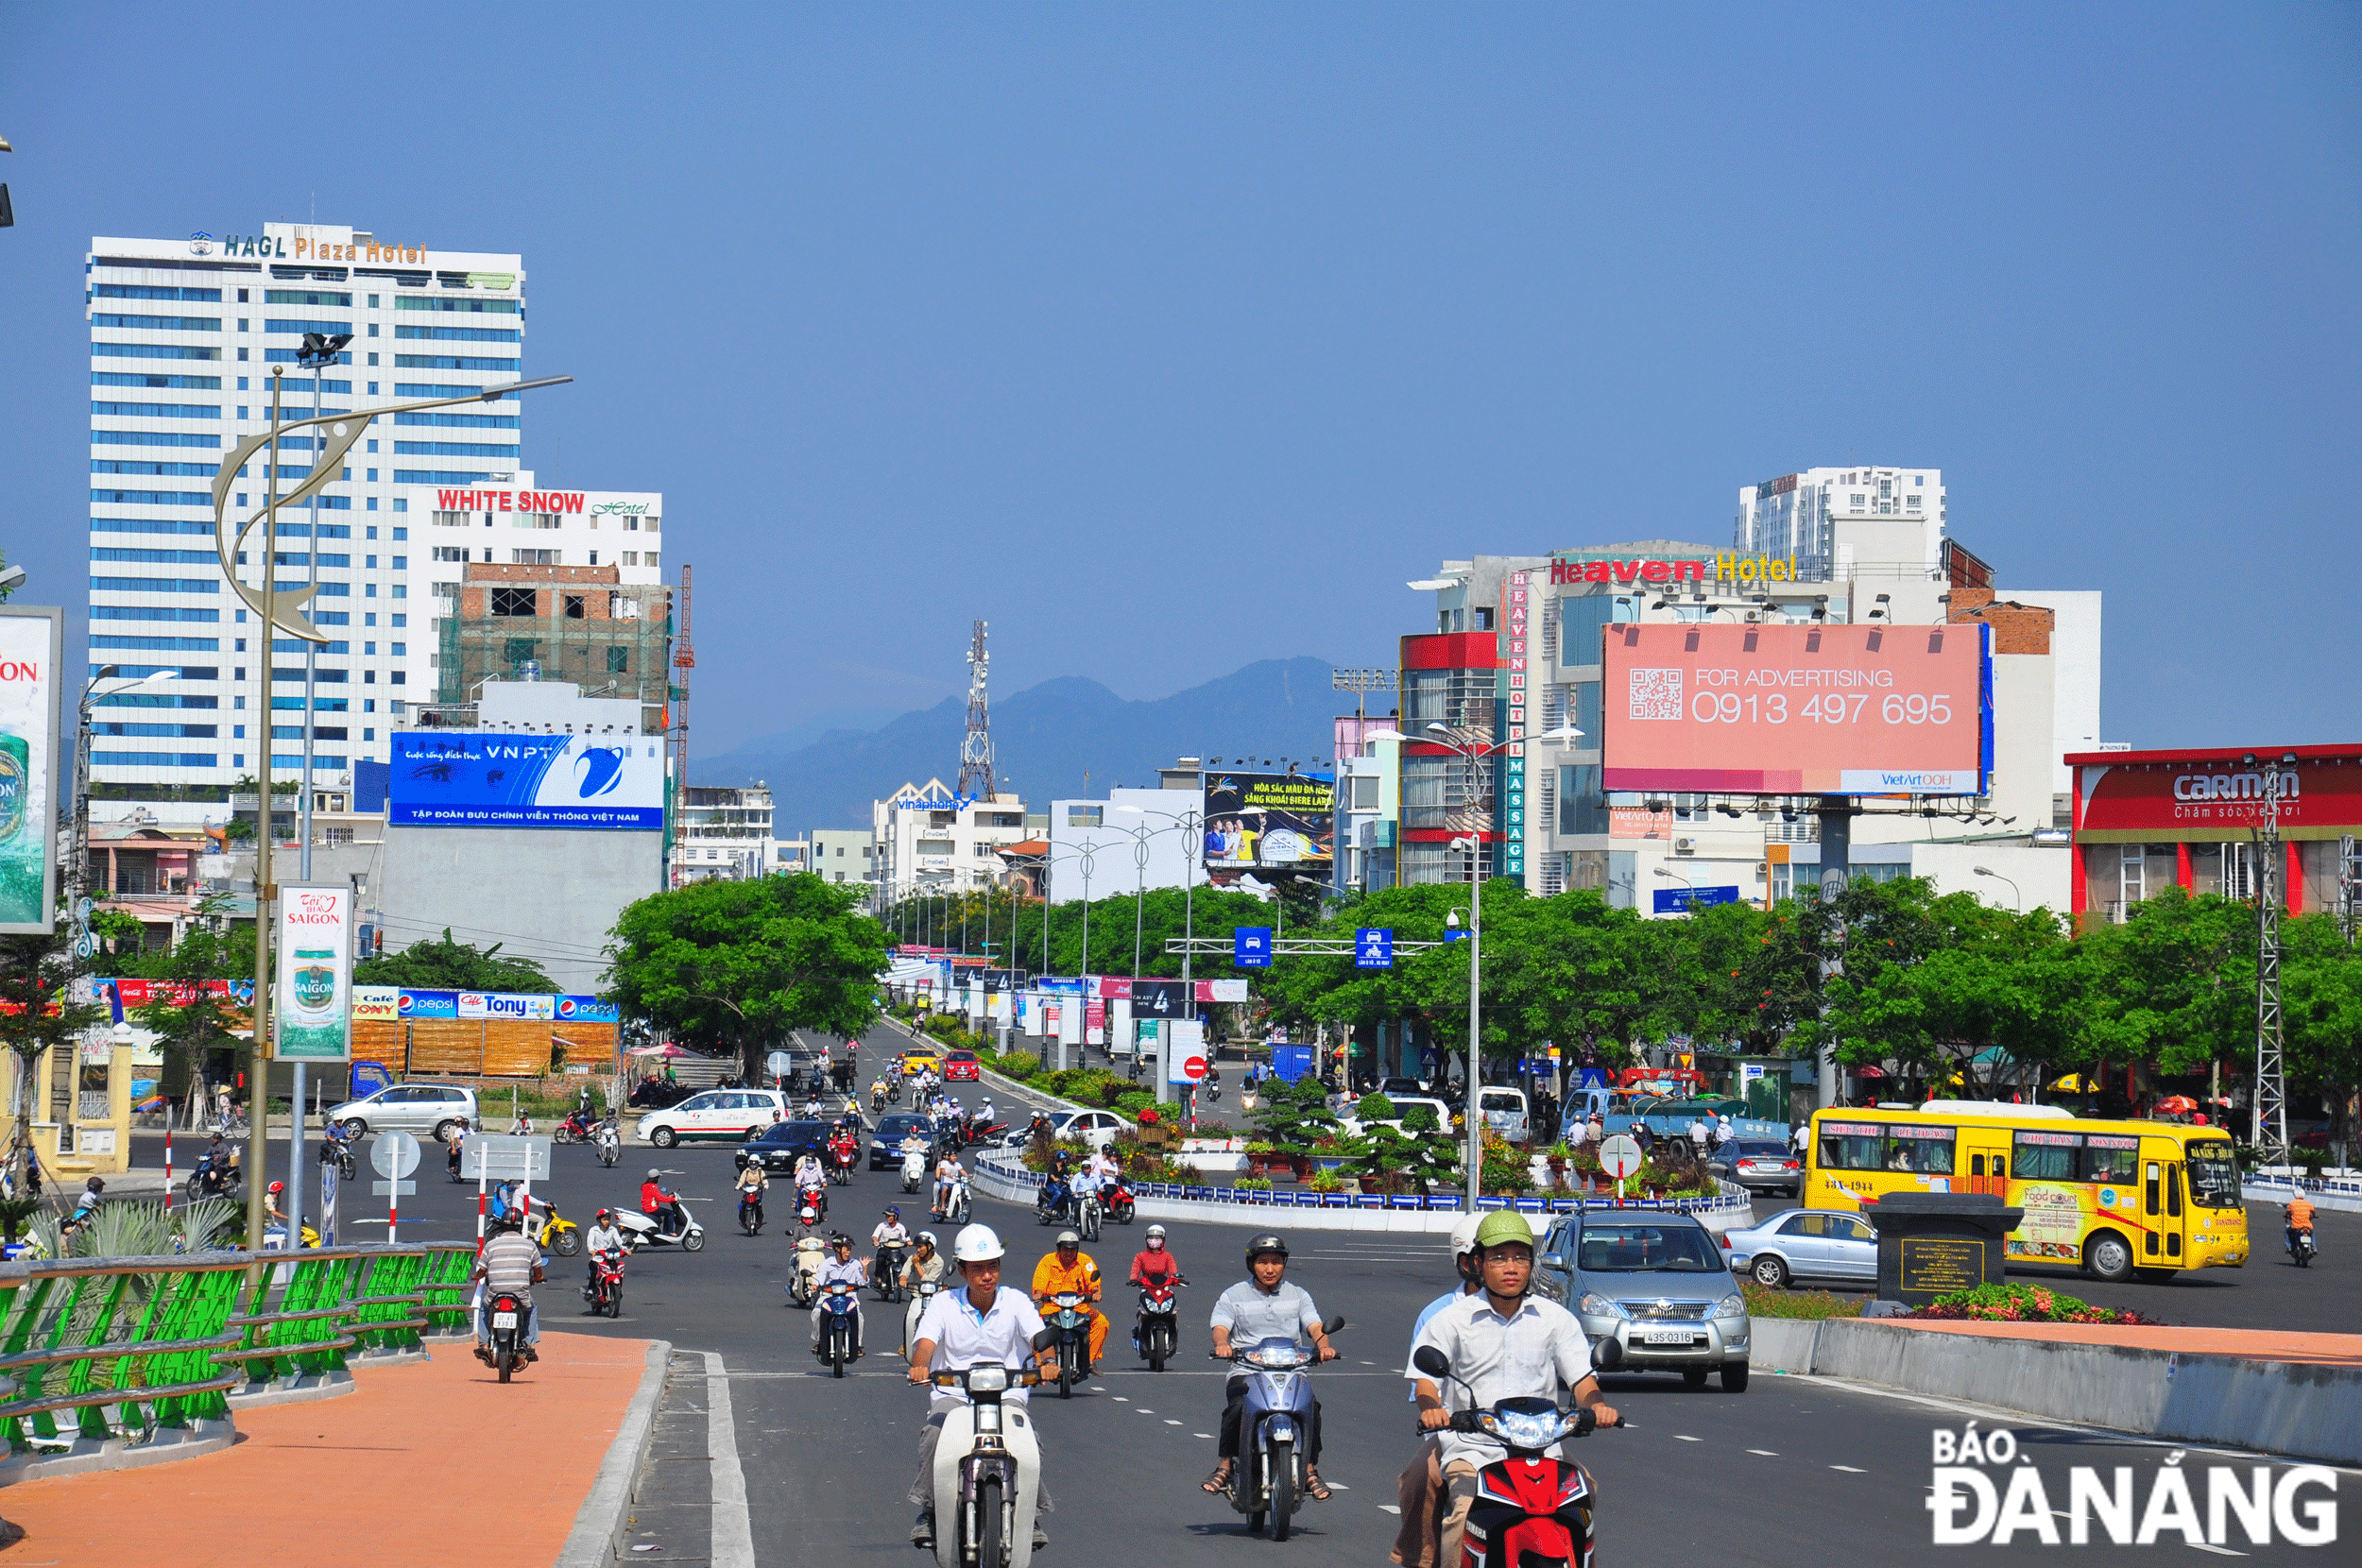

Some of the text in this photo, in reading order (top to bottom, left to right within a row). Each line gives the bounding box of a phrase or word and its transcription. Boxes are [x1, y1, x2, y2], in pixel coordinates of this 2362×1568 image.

[224, 234, 426, 264] HAGL Plaza Hotel
[437, 489, 650, 516] WHITE SNOW Hotel
[1549, 553, 1796, 585] Heaven Hotel
[1696, 669, 1893, 689] FOR ADVERTISING
[1691, 691, 1953, 725] 0913 497 695
[487, 746, 553, 759] VNPT
[898, 798, 959, 810] vinaphone
[412, 810, 432, 820] TẬP
[435, 810, 465, 821] ĐOÀN
[490, 810, 522, 820] CHÍNH
[552, 811, 589, 822] THÔNG
[617, 813, 640, 822] NAM
[288, 912, 340, 925] SAIGON
[295, 983, 334, 994] SAIGON
[363, 994, 394, 1003] Café
[418, 997, 454, 1013] pepsi
[484, 995, 526, 1017] Tony
[1154, 989, 1170, 1014] 4
[2025, 1188, 2048, 1202] food
